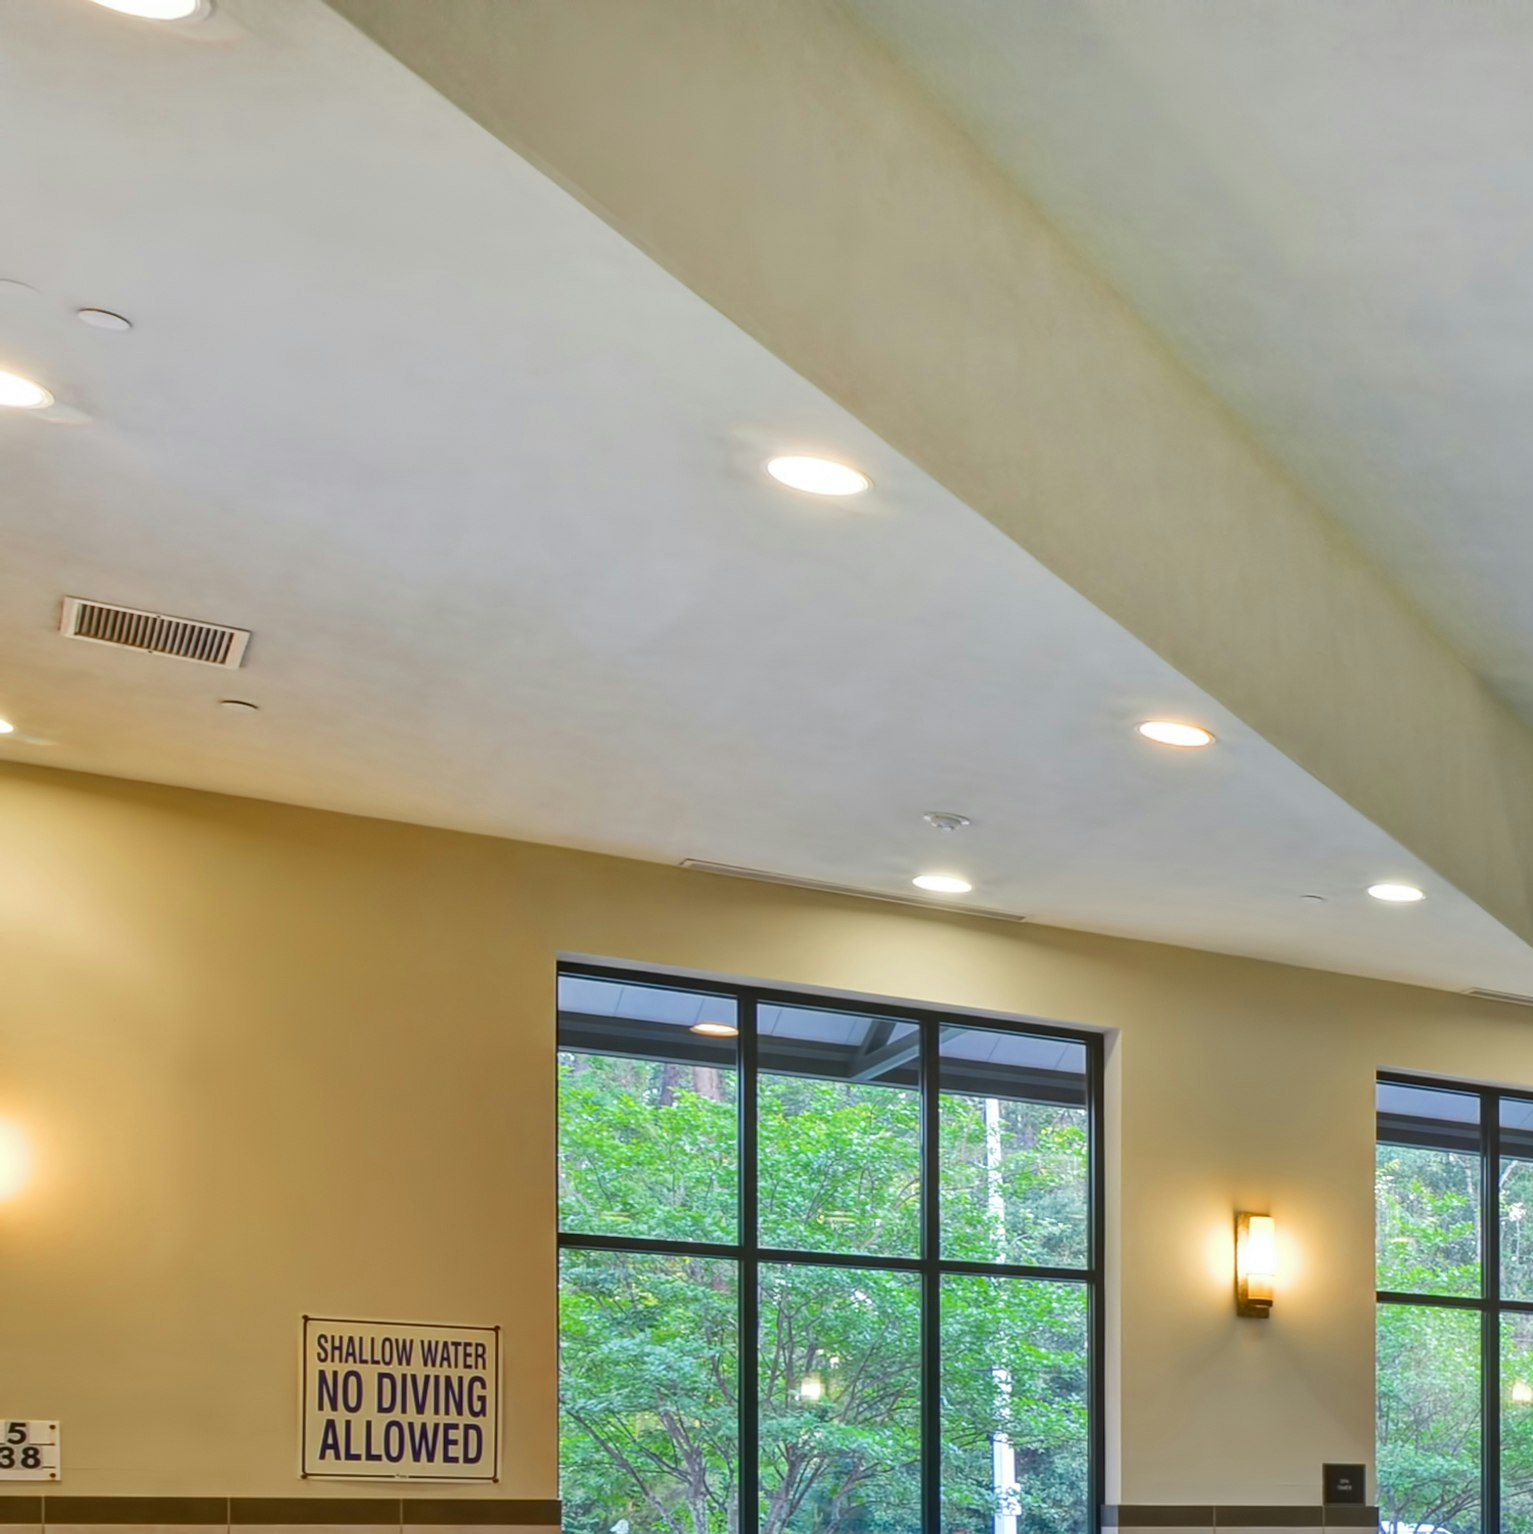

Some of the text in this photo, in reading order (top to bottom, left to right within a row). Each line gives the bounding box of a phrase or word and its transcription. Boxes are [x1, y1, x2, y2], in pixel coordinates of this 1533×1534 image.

[317, 1334, 487, 1370] SHALLOW WATER
[318, 1370, 487, 1418] NO DIVING
[7, 1422, 27, 1445] 5
[319, 1419, 483, 1464] ALLOWED
